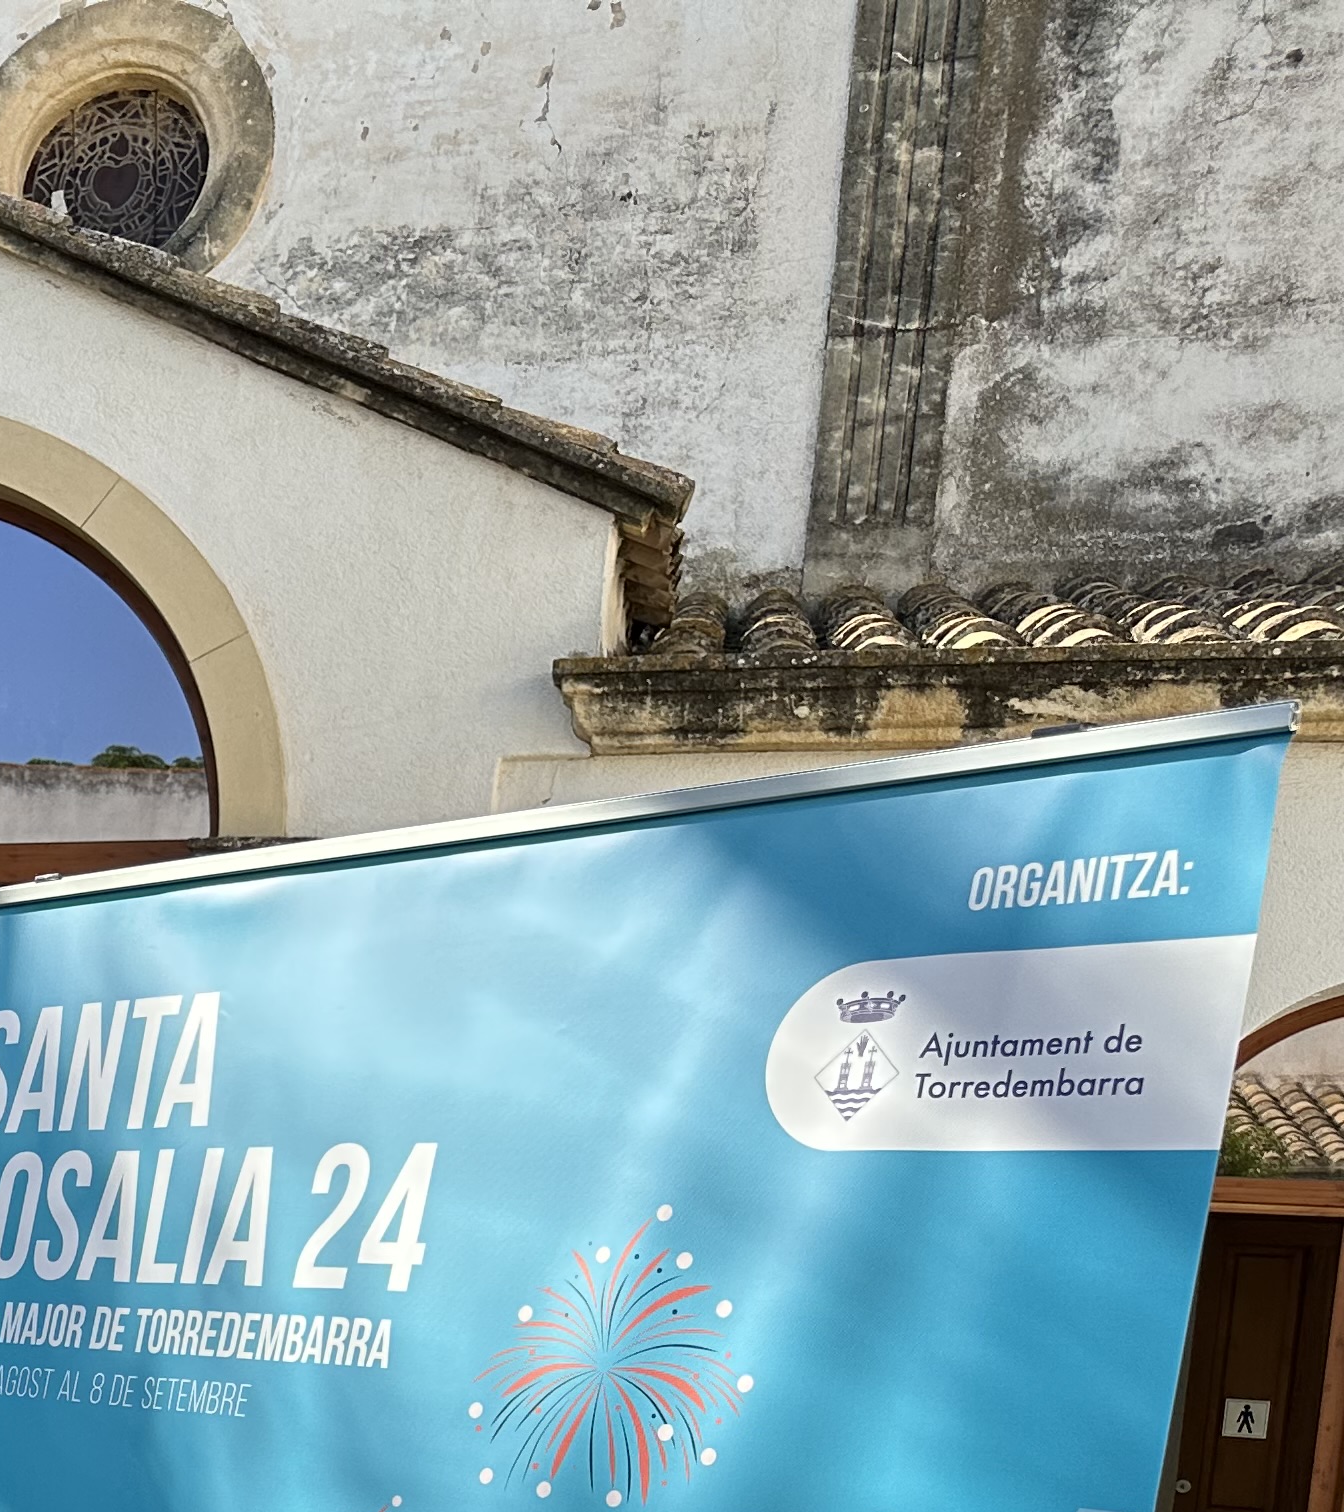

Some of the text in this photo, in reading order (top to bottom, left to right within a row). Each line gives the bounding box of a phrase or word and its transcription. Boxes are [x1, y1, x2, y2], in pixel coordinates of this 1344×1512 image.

[967, 849, 1194, 911] ORGANITZA:
[918, 1024, 1143, 1067] Ajuntament de
[915, 1069, 1145, 1099] Torredembarra
[292, 1142, 438, 1292] 24
[88, 1306, 129, 1353] DE
[133, 1307, 392, 1369] TORREDEMBARRA
[57, 1369, 83, 1402] AL
[89, 1373, 107, 1405] 8
[109, 1374, 138, 1408] DE
[141, 1377, 253, 1418] SETEMBRE
